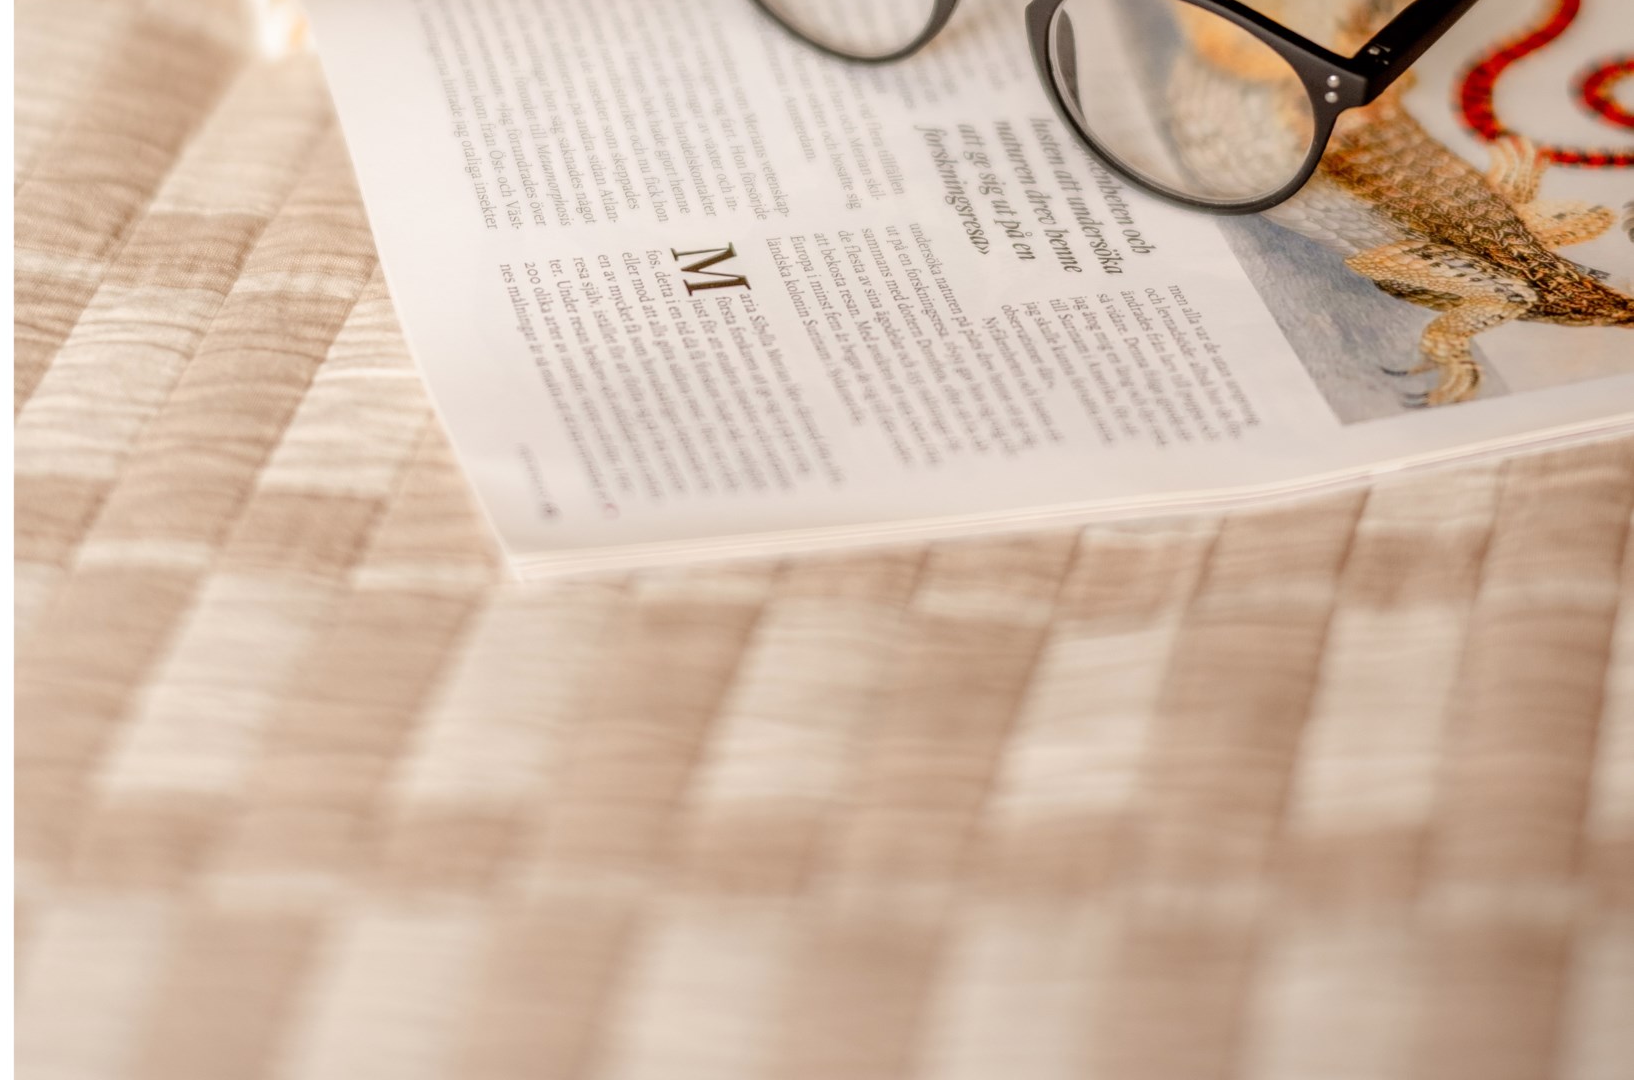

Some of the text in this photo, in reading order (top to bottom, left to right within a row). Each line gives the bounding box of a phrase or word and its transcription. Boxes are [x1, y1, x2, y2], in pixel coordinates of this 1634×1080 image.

[461, 140, 498, 230] otaliga insekter
[505, 128, 539, 199] förundrades
[534, 143, 575, 227] Metamorphosis
[557, 137, 598, 225] saknades något
[586, 154, 619, 224] sidan Atlan-
[610, 152, 641, 210] skeppades
[653, 149, 691, 214] gjort henne
[672, 121, 717, 217] handelskontakter
[741, 111, 790, 218] Merians vetenskap-
[829, 153, 854, 192] bosatte
[877, 149, 905, 196] tillfällen
[978, 172, 1007, 196] sig
[505, 200, 524, 230] Väst-
[739, 171, 771, 221] försörjde
[990, 198, 1018, 217] ut
[994, 120, 1083, 273] naturen drev henne
[1029, 118, 1124, 275] lusten att undersöka
[993, 219, 1033, 239] på
[1012, 242, 1037, 261] en
[1122, 229, 1157, 254] och
[523, 262, 554, 314] 200 olika
[572, 256, 590, 280] resa
[621, 251, 656, 304] eller mod
[653, 271, 674, 298] detta
[765, 237, 812, 318] ländska kolonin
[789, 235, 834, 311] Europa minst
[820, 247, 861, 319] bekosta resan.
[843, 244, 883, 310] flesta sina
[861, 227, 924, 338] sammans dottern
[908, 222, 963, 315] undersöka naturen
[556, 279, 580, 314] Under
[607, 284, 635, 323] mycket
[714, 296, 737, 326] första
[1081, 311, 1102, 332] åtog
[1119, 290, 1154, 332] ändrades
[1181, 307, 1203, 325] alla
[1057, 313, 1090, 354] Surinam
